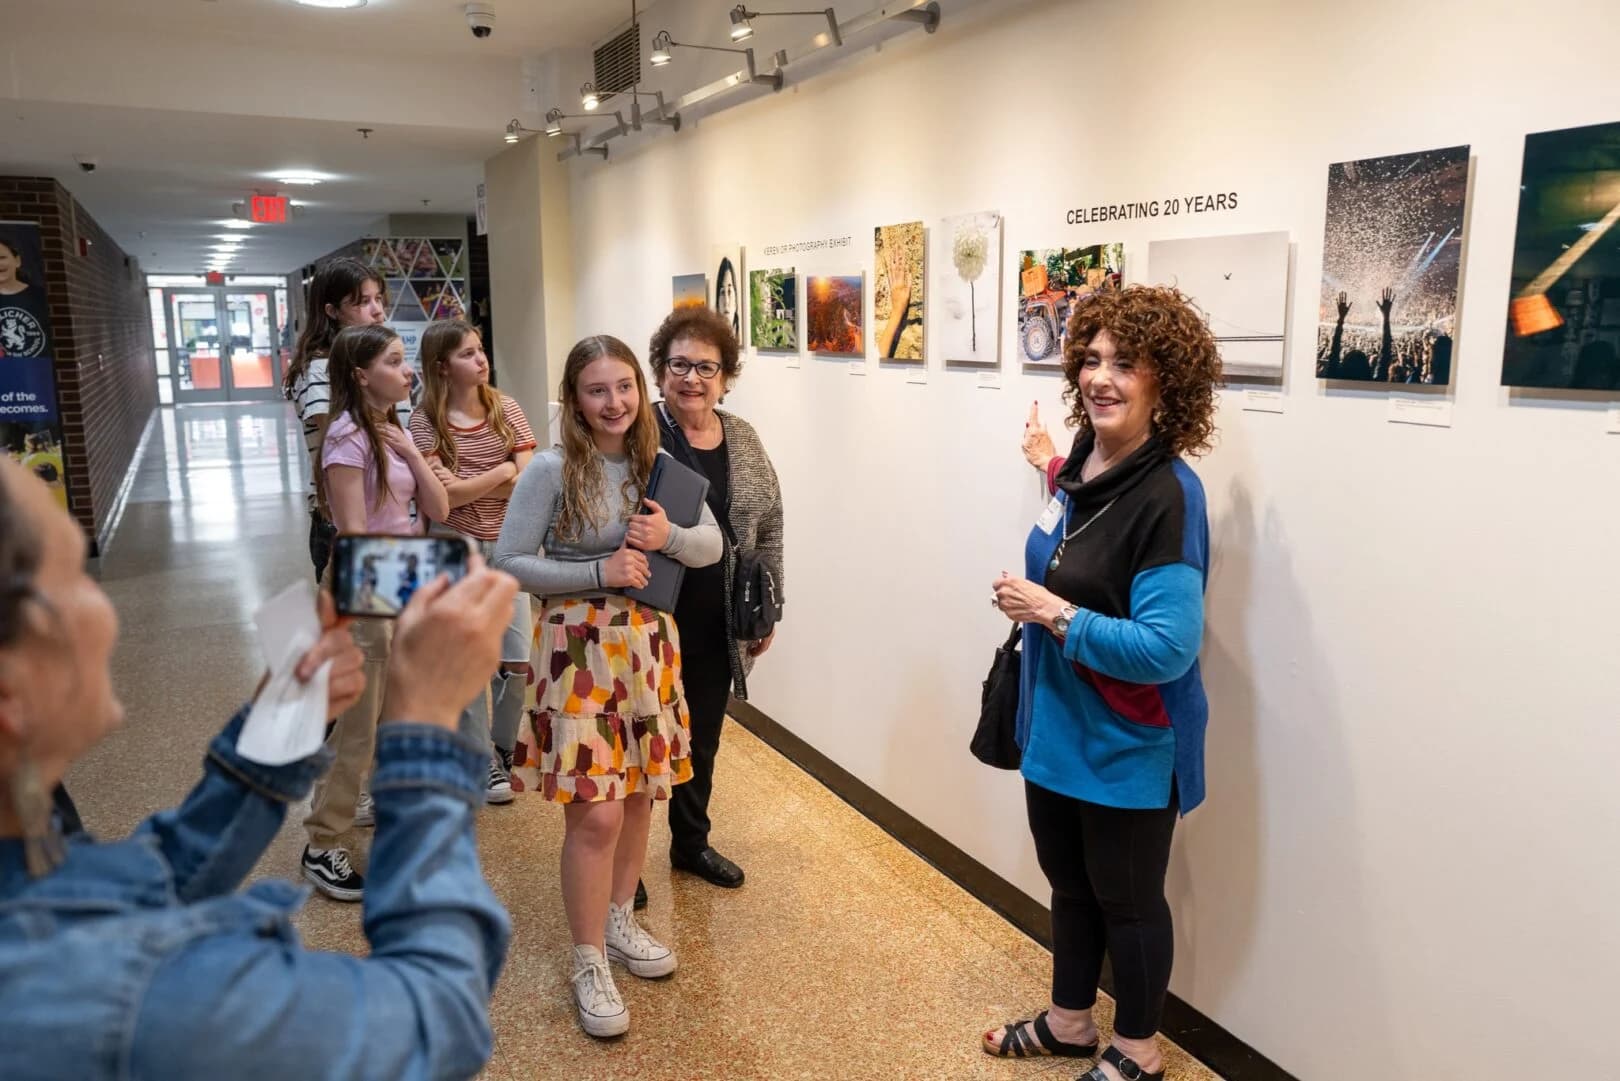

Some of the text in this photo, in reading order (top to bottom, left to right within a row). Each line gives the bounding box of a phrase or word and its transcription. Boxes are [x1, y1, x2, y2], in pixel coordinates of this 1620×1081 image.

[1066, 192, 1239, 225] CELEBRATING 20 YEARS
[788, 240, 828, 253] PHOTOGRAPHY
[829, 236, 852, 248] EXHIBIT
[1, 392, 36, 401] of the
